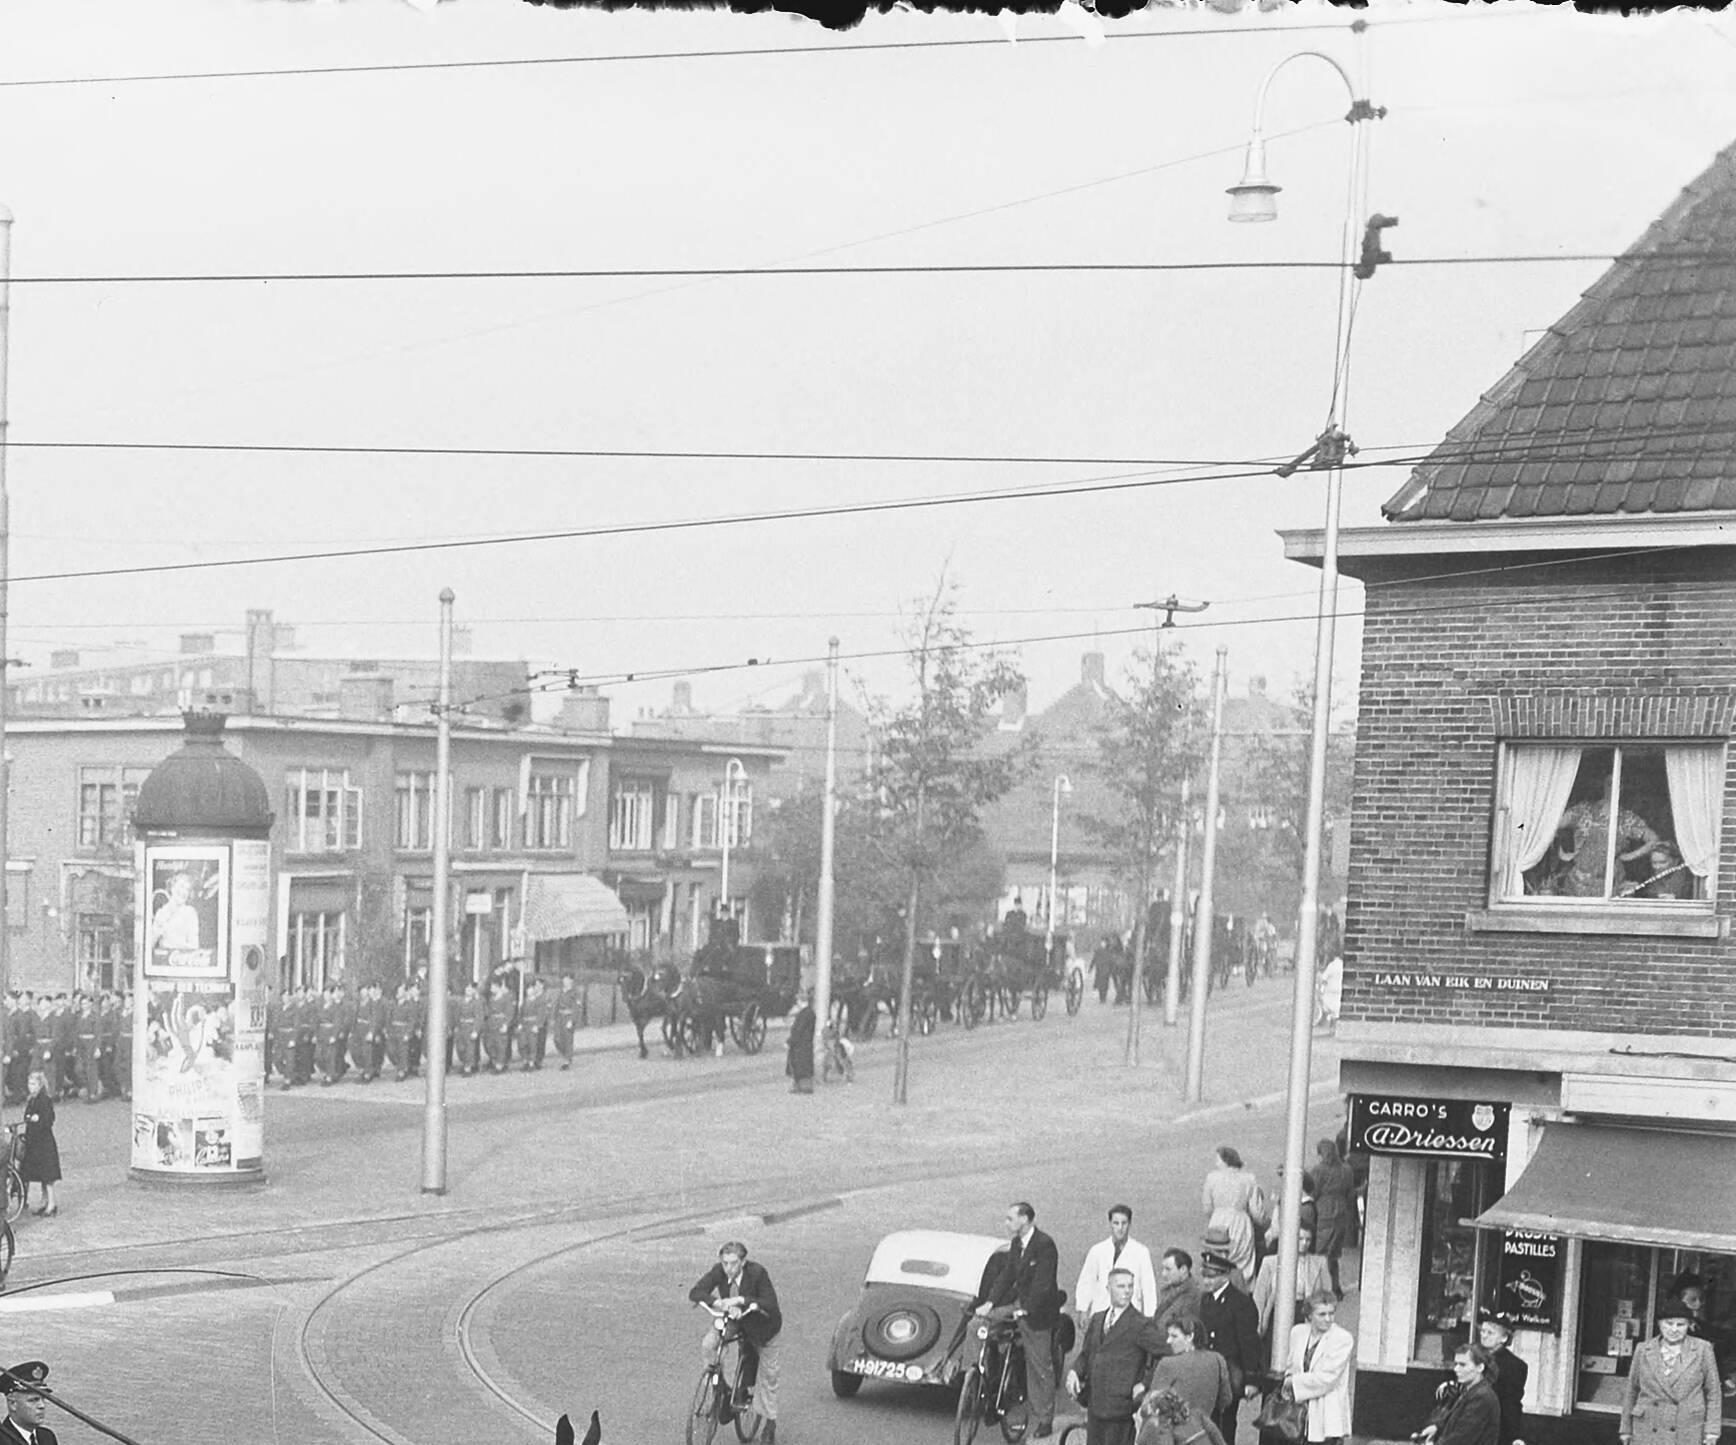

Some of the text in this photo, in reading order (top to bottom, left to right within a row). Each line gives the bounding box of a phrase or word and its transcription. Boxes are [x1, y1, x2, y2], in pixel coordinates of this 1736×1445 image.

[1375, 974, 1549, 990] LAAN VAN EIK EN DUINEN
[1369, 1101, 1448, 1119] CARRO'S
[1504, 1241, 1556, 1258] PASTILLES
